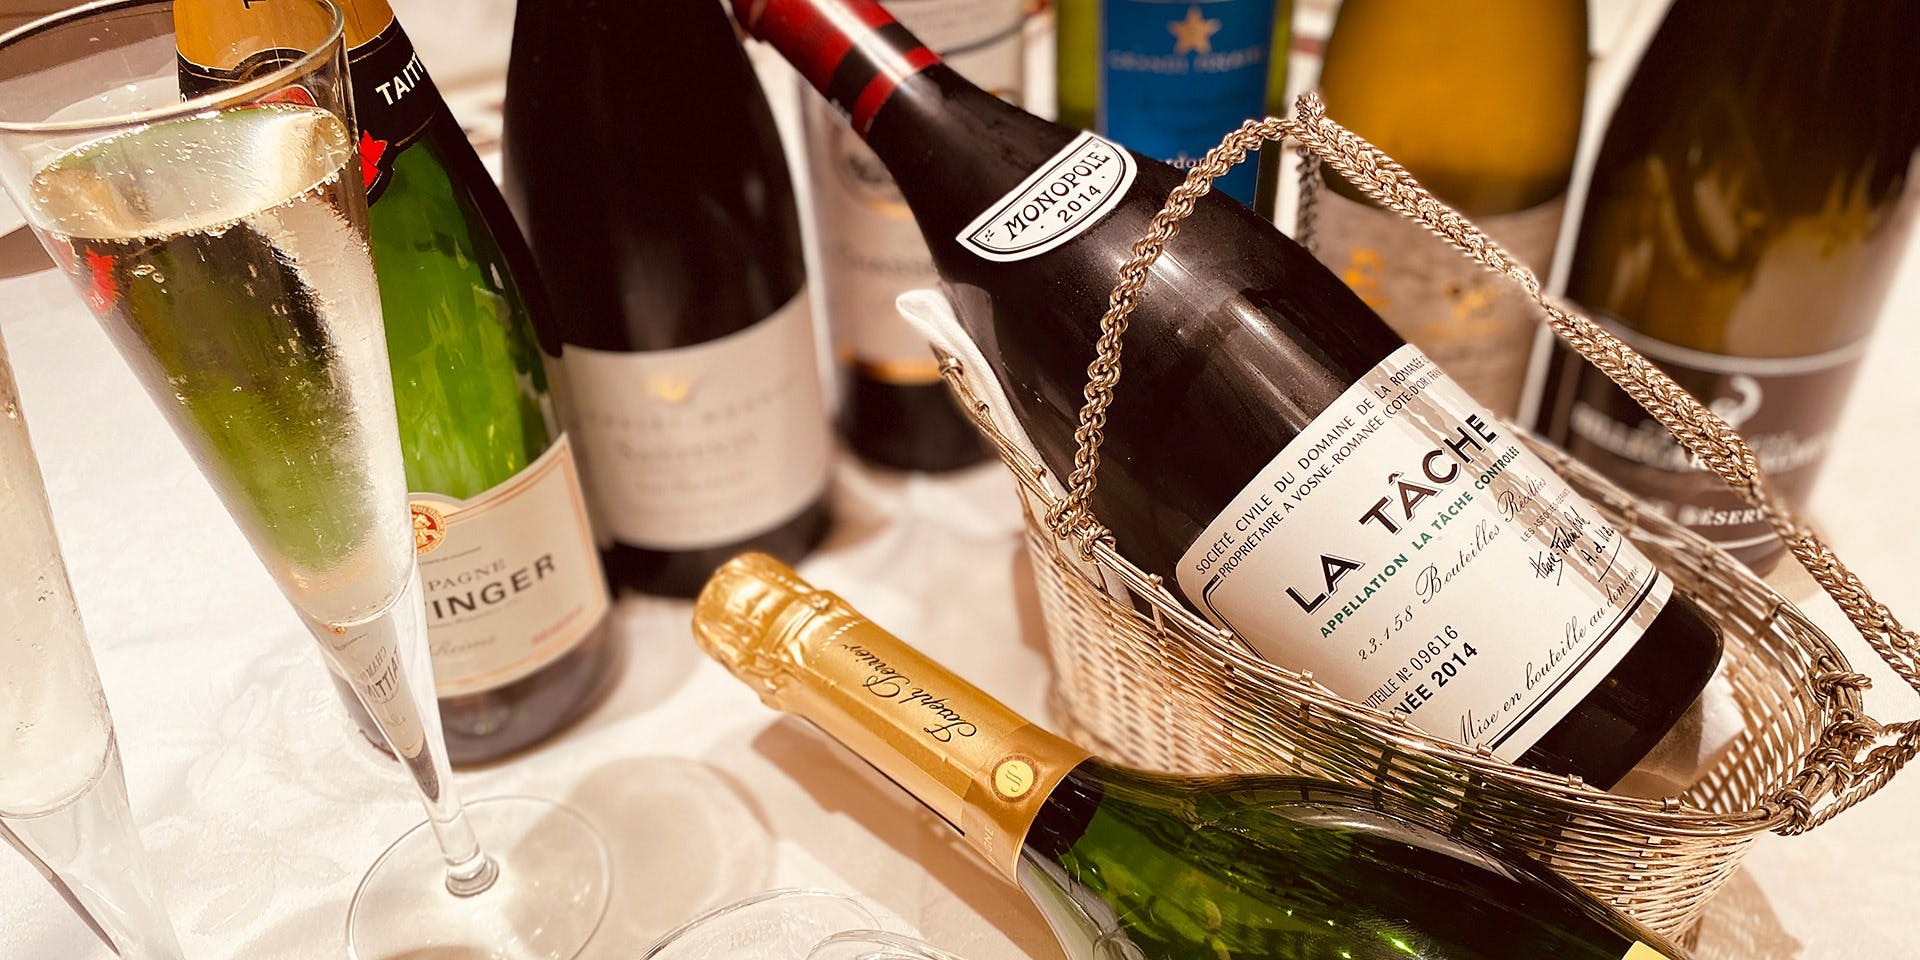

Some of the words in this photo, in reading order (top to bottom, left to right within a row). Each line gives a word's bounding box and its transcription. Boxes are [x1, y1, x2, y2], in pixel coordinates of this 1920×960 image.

[1003, 151, 1111, 242] MONOPOLE
[1057, 185, 1102, 223] 2014
[1196, 532, 1235, 575] SOCIÉTÉ
[1235, 493, 1273, 532] CIVILE
[1273, 471, 1295, 493] DU
[1297, 415, 1356, 470] DOMAINE
[1356, 398, 1375, 416] DE
[1374, 385, 1392, 400] LA
[1285, 553, 1366, 615] LA
[1358, 413, 1500, 536] TÂCHE
[1218, 510, 1284, 578] PROPRIÉTAIRE
[1283, 502, 1295, 513] A
[1320, 553, 1409, 638] APPELLATION
[1411, 532, 1433, 550] LA
[1431, 491, 1474, 530] TÂCHE
[1520, 527, 1535, 542] LES
[426, 558, 507, 592] PAGNE
[428, 553, 556, 619] INGER
[1358, 605, 1413, 661] 23.158
[1415, 519, 1500, 604] Bouteilles
[842, 643, 911, 698] Perrier
[1389, 684, 1434, 716] NÉE
[1430, 642, 1478, 687] 2014
[1409, 625, 1458, 671] 09616
[1460, 708, 1499, 745] Mise
[1502, 691, 1523, 713] en
[1525, 615, 1587, 691] bouteille
[1589, 605, 1606, 628] au
[898, 687, 977, 743] Joseph
